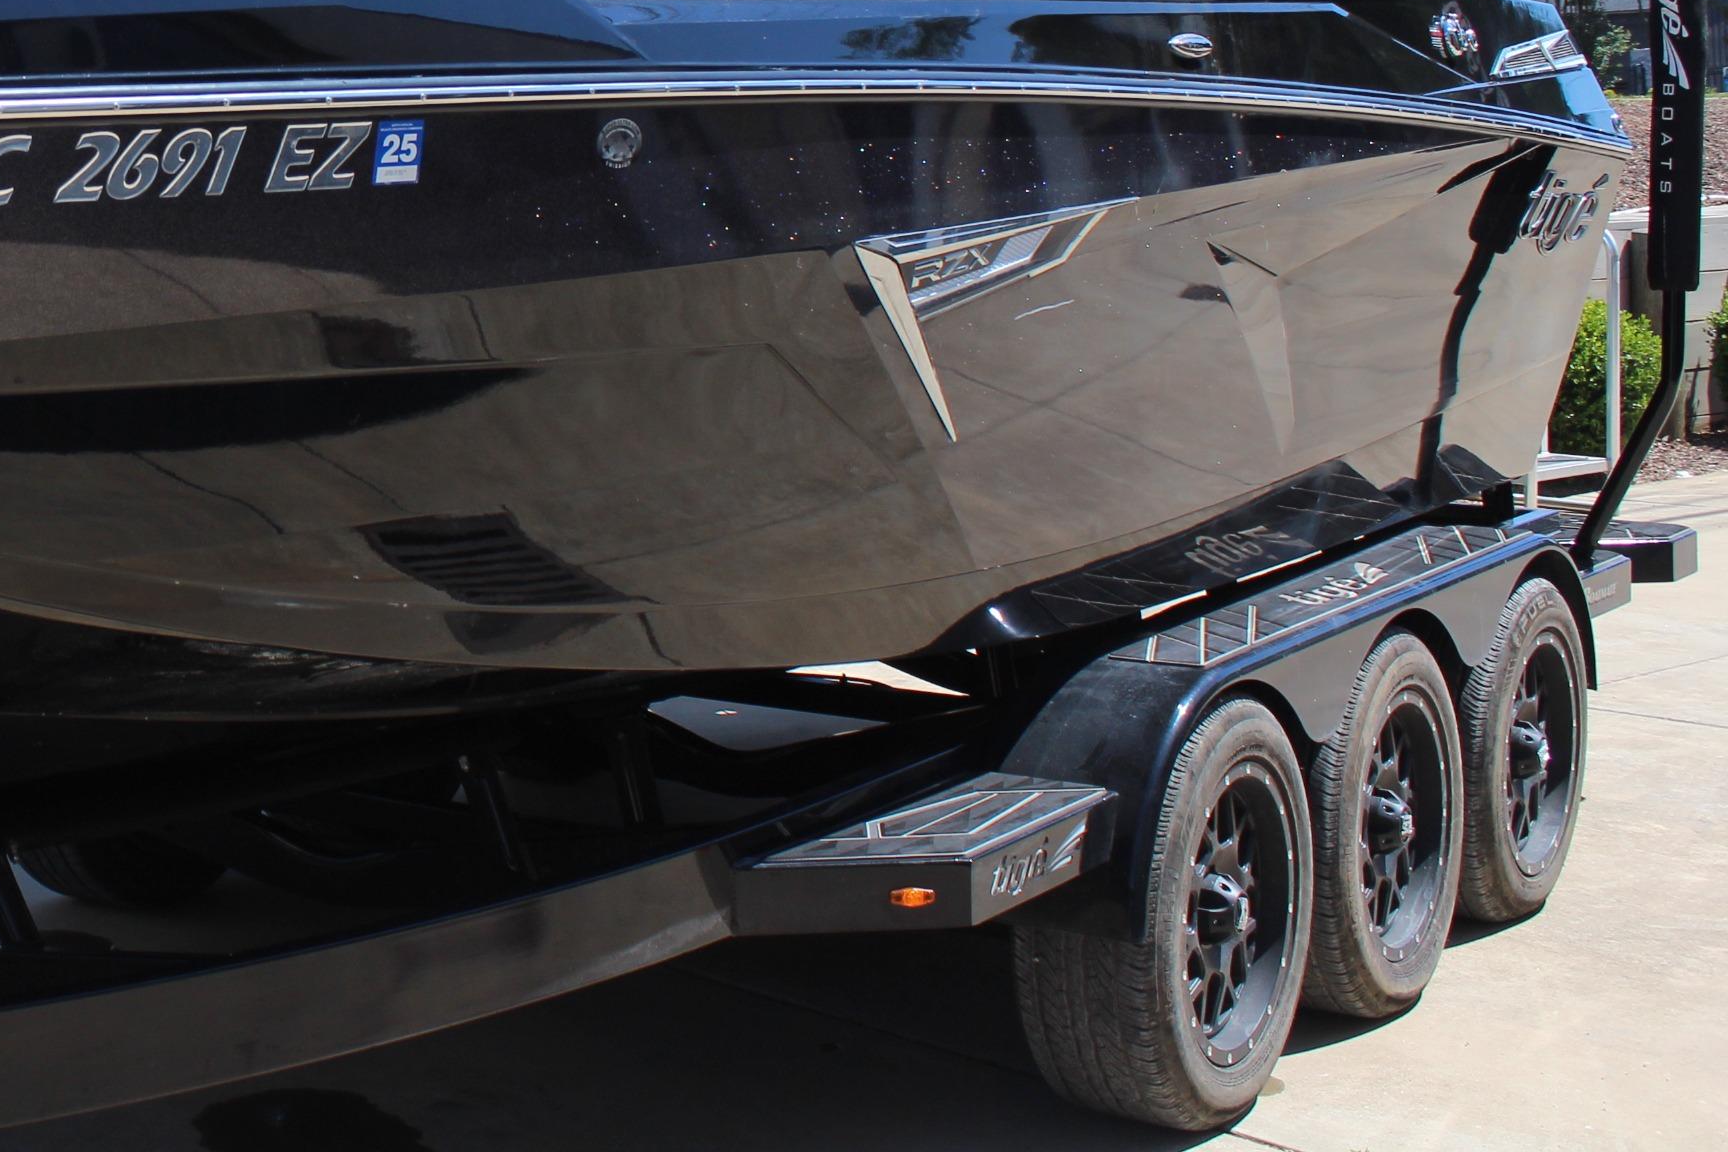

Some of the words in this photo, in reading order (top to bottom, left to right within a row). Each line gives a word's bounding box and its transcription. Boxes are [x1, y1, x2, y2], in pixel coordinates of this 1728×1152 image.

[53, 126, 247, 203] 2691
[264, 121, 372, 193] EZ
[381, 133, 418, 164] 25
[1659, 83, 1675, 193] BOATS
[911, 243, 992, 289] RZX
